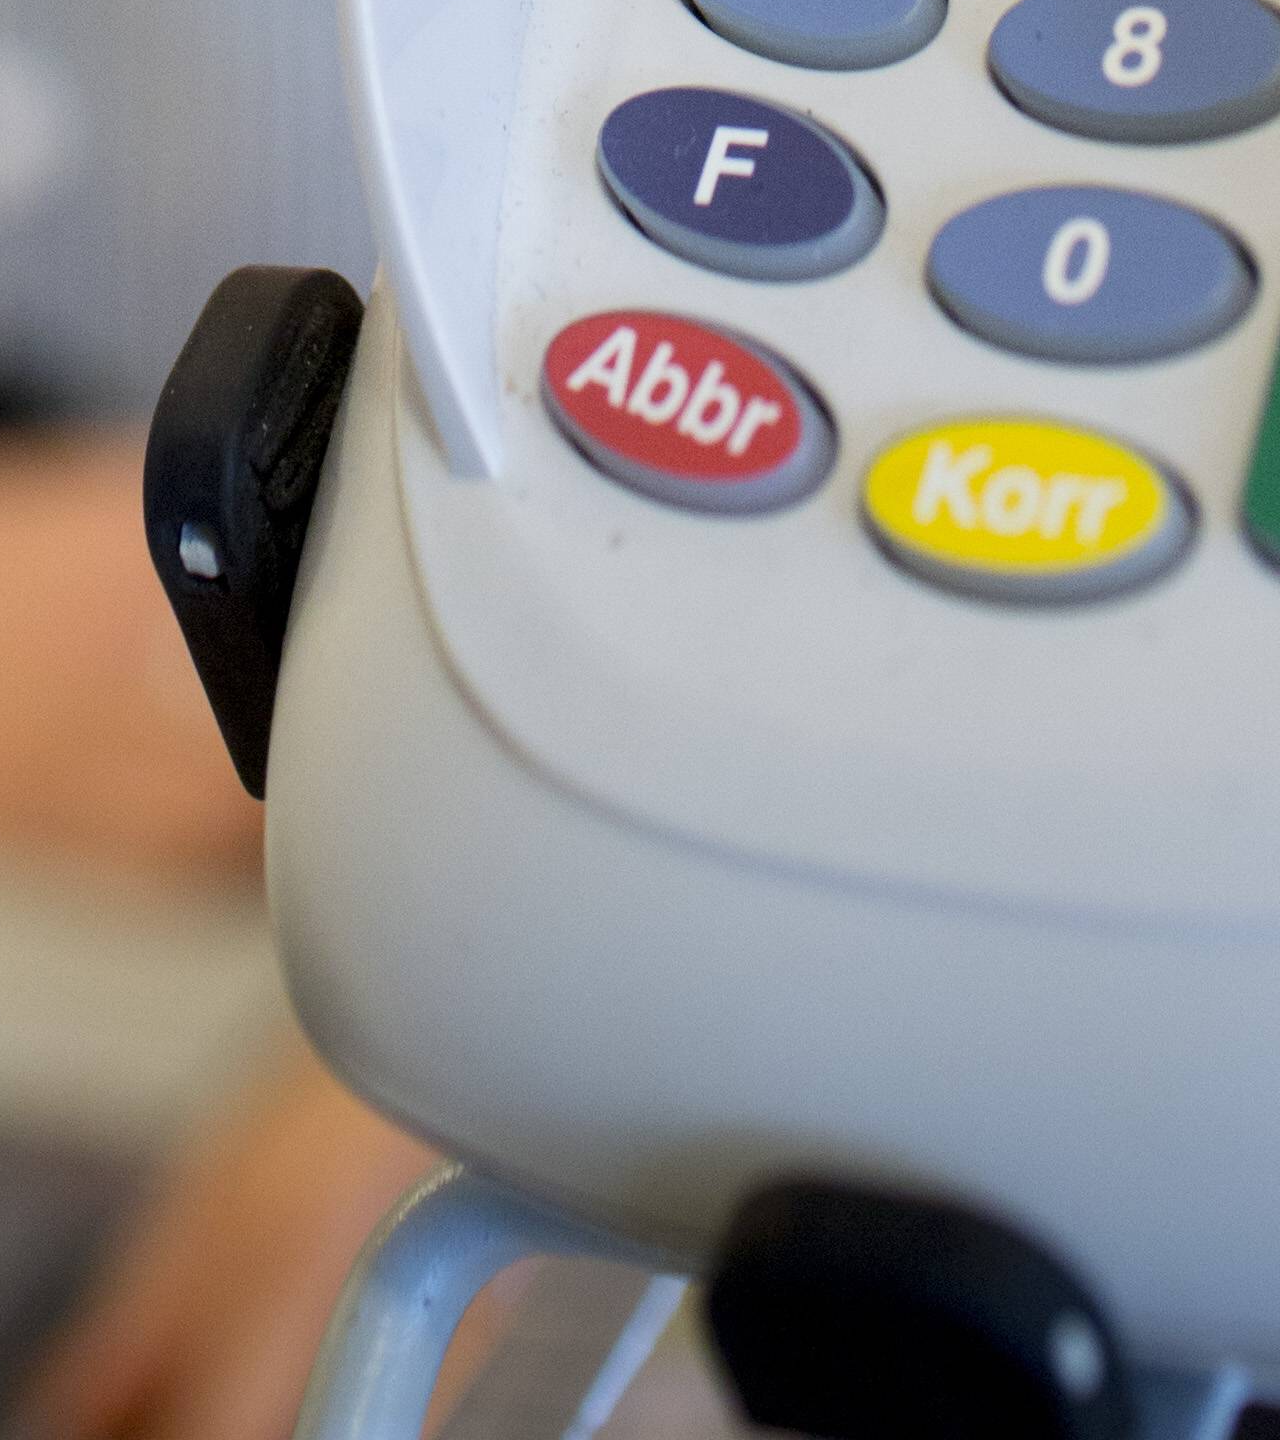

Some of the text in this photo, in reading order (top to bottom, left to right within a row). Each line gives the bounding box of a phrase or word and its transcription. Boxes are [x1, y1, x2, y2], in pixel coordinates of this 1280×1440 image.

[1101, 6, 1168, 88] 8
[692, 125, 770, 207] F
[1042, 218, 1111, 306] 0
[566, 324, 783, 458] Abbr
[912, 442, 1126, 542] Korr
